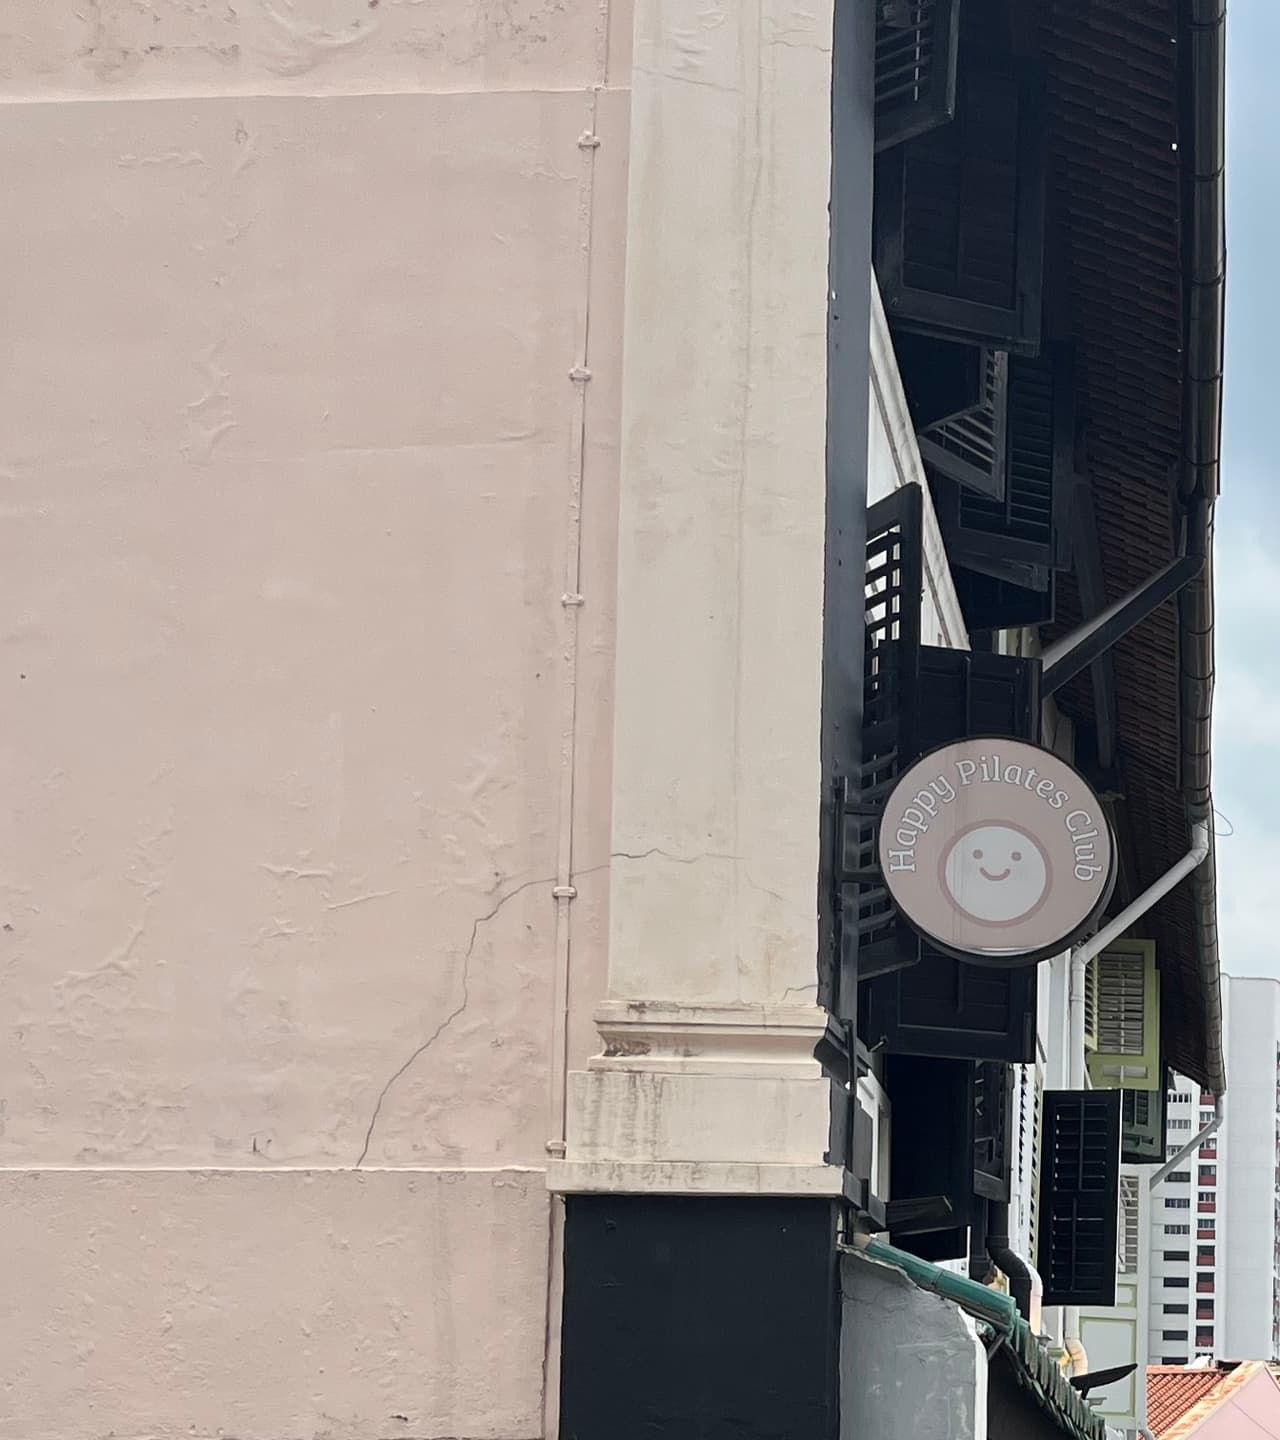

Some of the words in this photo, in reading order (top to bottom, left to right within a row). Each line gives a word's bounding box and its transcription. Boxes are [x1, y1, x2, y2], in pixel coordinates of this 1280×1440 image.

[888, 773, 957, 873] Happy
[954, 755, 1069, 811] Pilates
[1064, 809, 1104, 882] Club
